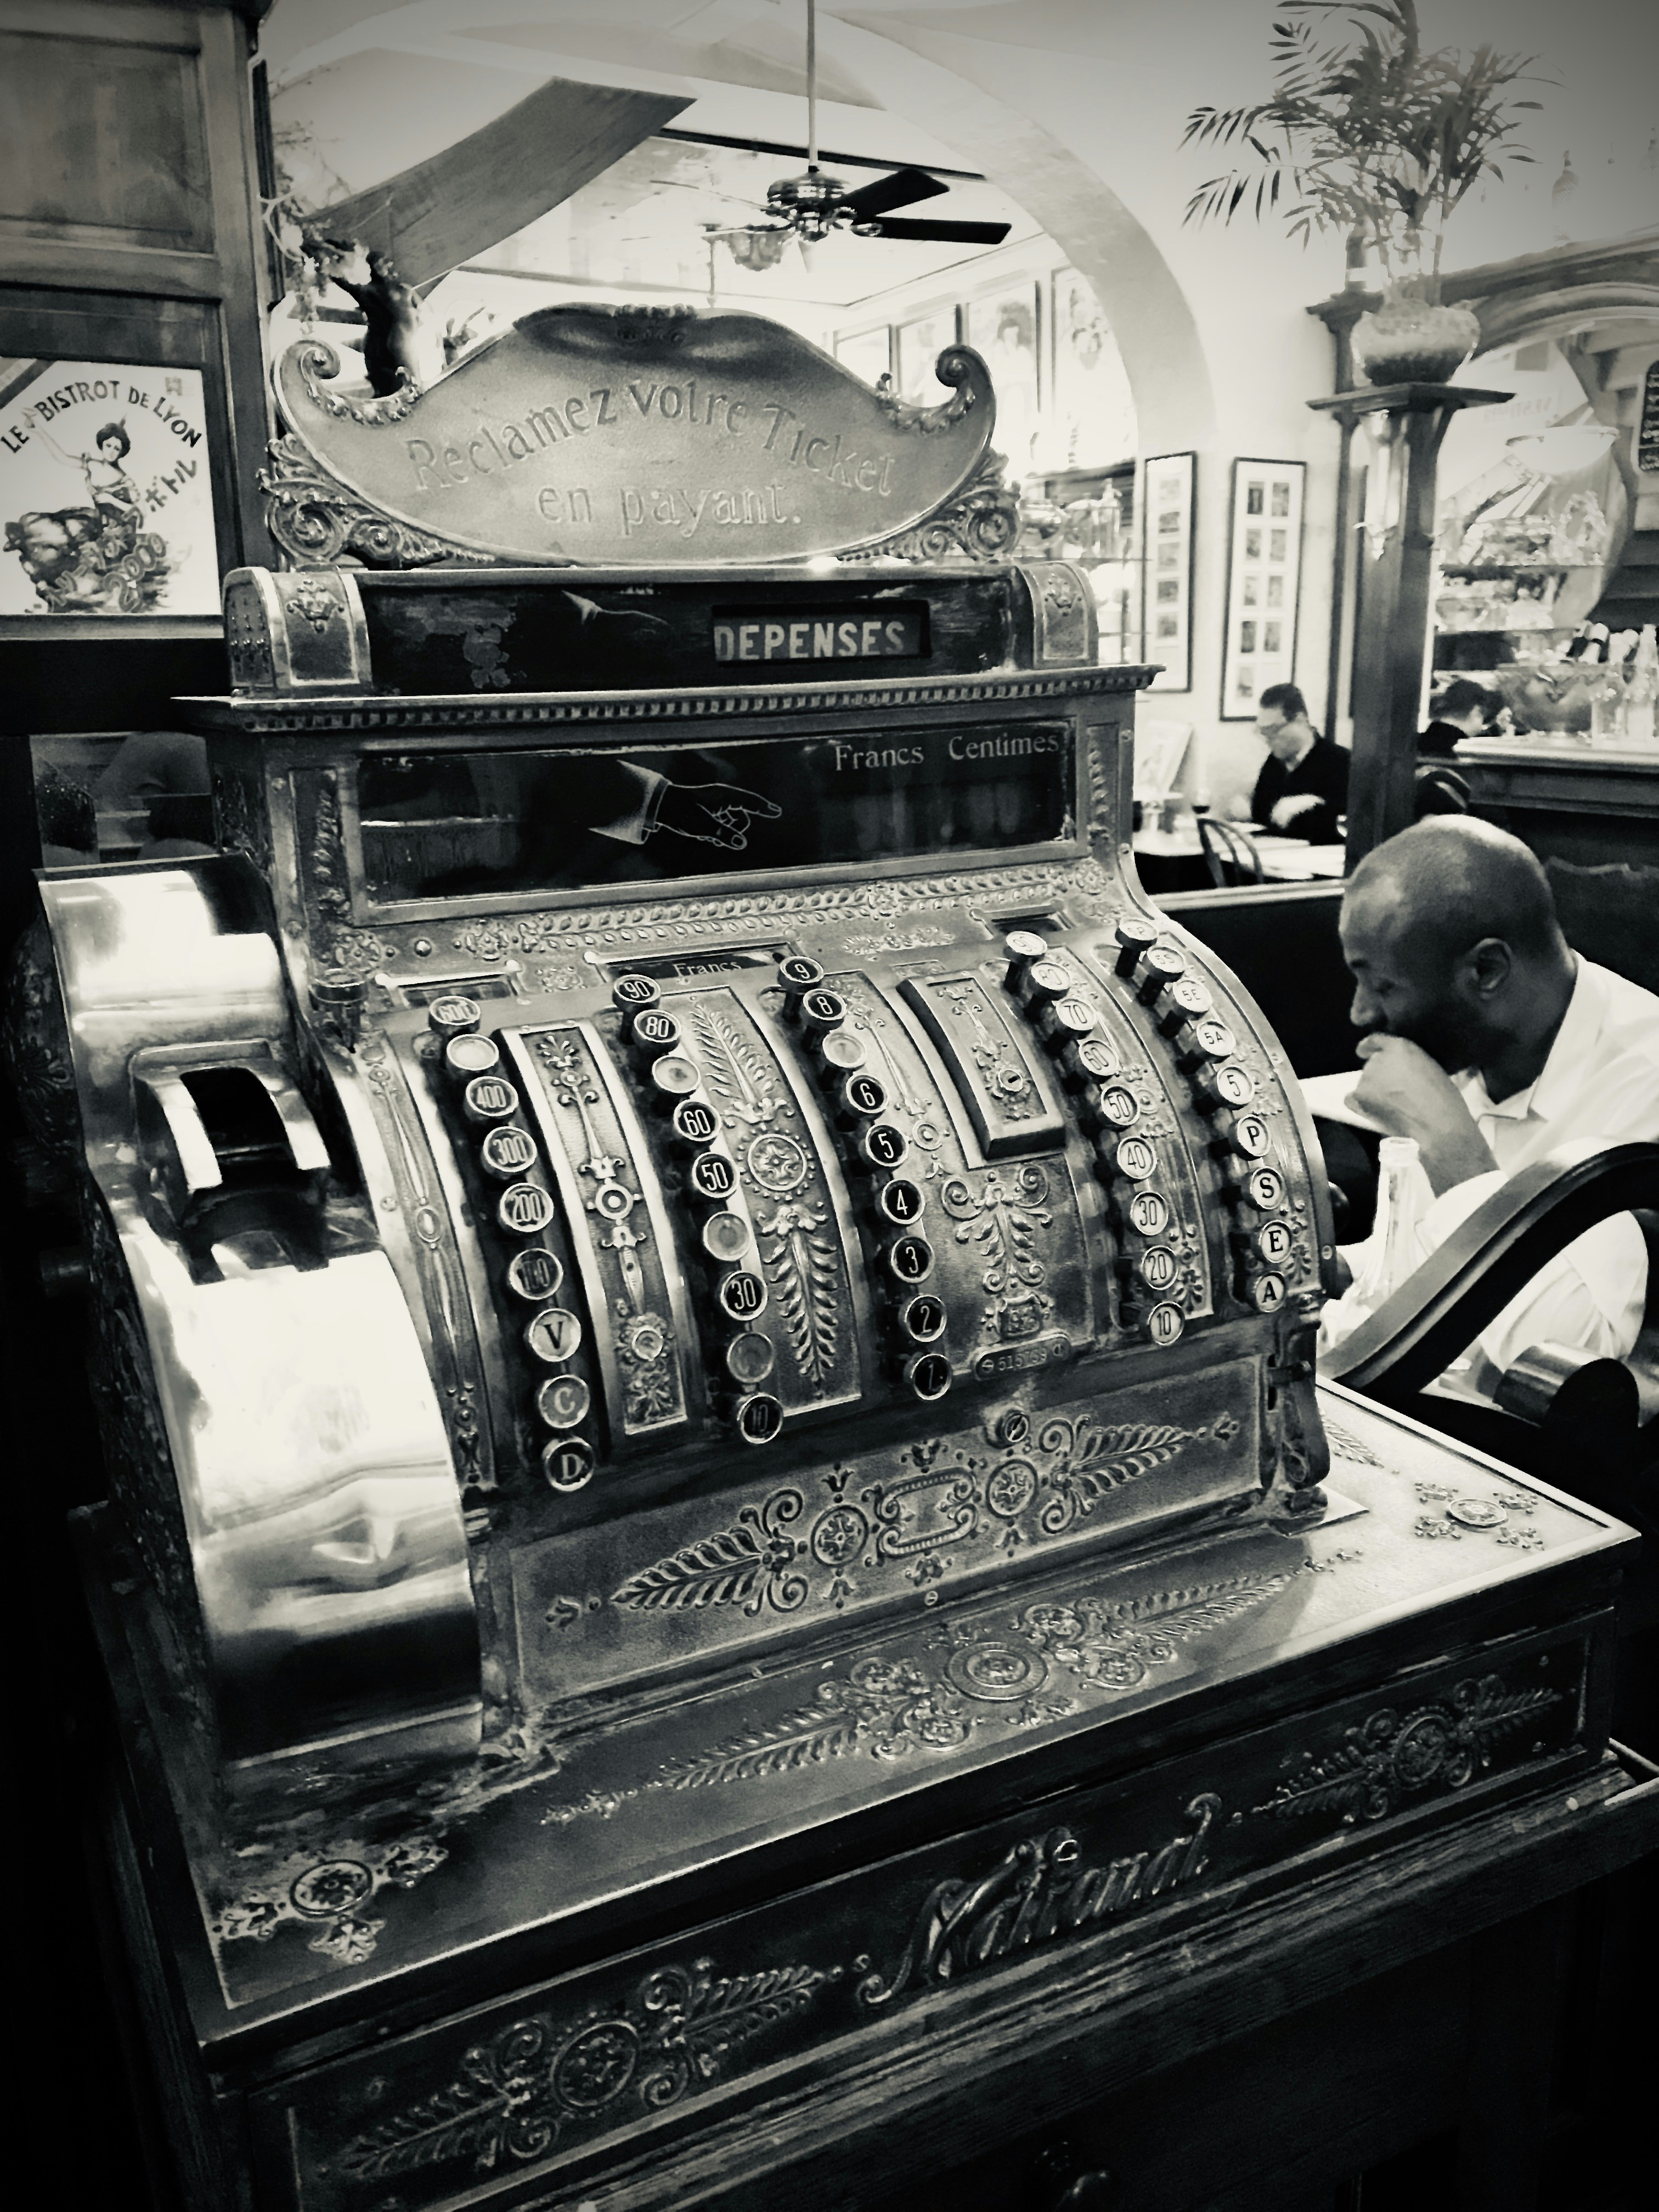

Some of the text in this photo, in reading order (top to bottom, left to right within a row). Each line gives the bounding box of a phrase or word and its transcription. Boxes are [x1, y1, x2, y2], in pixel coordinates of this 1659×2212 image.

[1, 425, 30, 453] LE
[35, 380, 120, 421] BISTROT
[128, 386, 149, 409] DE
[154, 397, 202, 448] LYON
[626, 379, 748, 434] votre
[762, 403, 894, 496] Ticket
[535, 482, 802, 538] en payant.
[715, 620, 905, 660] DEPENSES
[835, 732, 1059, 770] Francs Centimes
[674, 961, 742, 977] Francs
[794, 963, 810, 980] 9
[627, 980, 650, 998] 90
[1182, 989, 1201, 1002] 5E
[816, 997, 833, 1015] 8
[1064, 1005, 1087, 1024] 70
[646, 1017, 669, 1037] 80
[1205, 1030, 1224, 1045] 5A
[1084, 1047, 1109, 1071] 60
[477, 1085, 506, 1108] 400
[860, 1083, 876, 1107] 6
[1227, 1074, 1243, 1097] 5
[1108, 1094, 1131, 1120] 50
[684, 1109, 711, 1136] 60
[878, 1132, 893, 1159] 5
[1247, 1125, 1260, 1147] P
[493, 1137, 528, 1164] 300
[1127, 1145, 1146, 1169] 40
[701, 1162, 729, 1192] 50
[1260, 1177, 1274, 1199] S
[511, 1193, 542, 1222] 200
[895, 1189, 907, 1216] 4
[1139, 1200, 1157, 1226] 30
[1268, 1230, 1283, 1253] E
[906, 1246, 918, 1274] 3
[1148, 1254, 1167, 1281] 20
[730, 1278, 757, 1310] 30
[1262, 1281, 1278, 1304] A
[920, 1306, 933, 1333] 2
[1156, 1312, 1172, 1335] 10
[543, 1321, 563, 1349] V
[554, 1386, 575, 1415] C
[752, 1403, 769, 1432] 10
[561, 1453, 584, 1480] D
